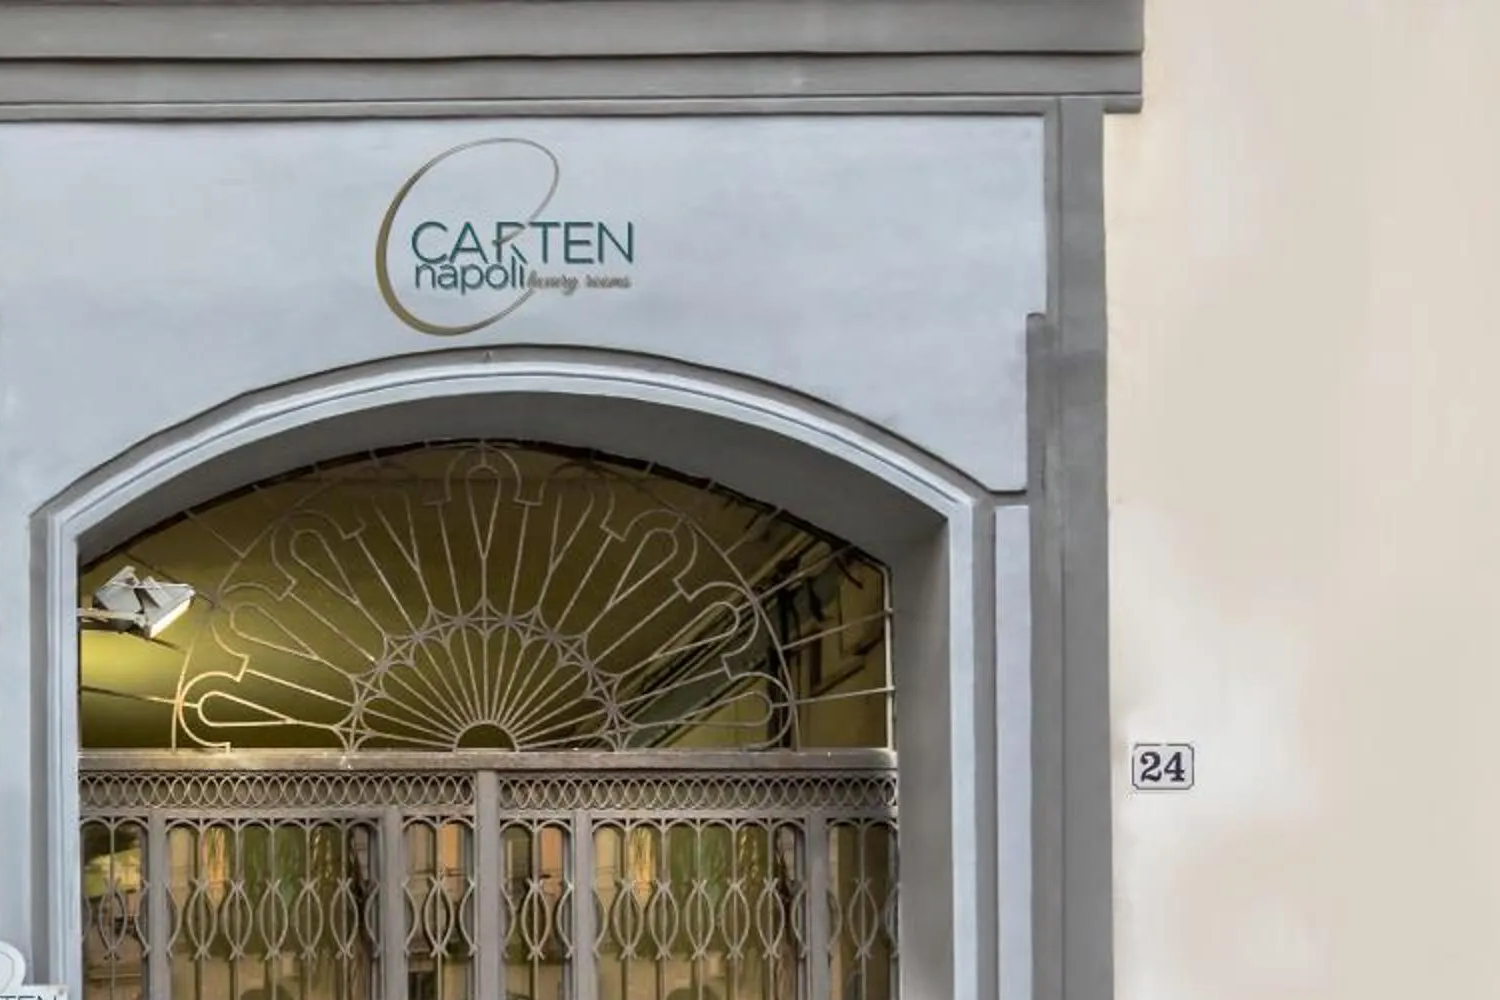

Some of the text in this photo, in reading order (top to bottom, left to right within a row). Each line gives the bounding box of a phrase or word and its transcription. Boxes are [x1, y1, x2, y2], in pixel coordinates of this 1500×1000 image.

[411, 220, 634, 264] CARTEN
[414, 255, 525, 295] napoli
[1140, 751, 1185, 782] 24
